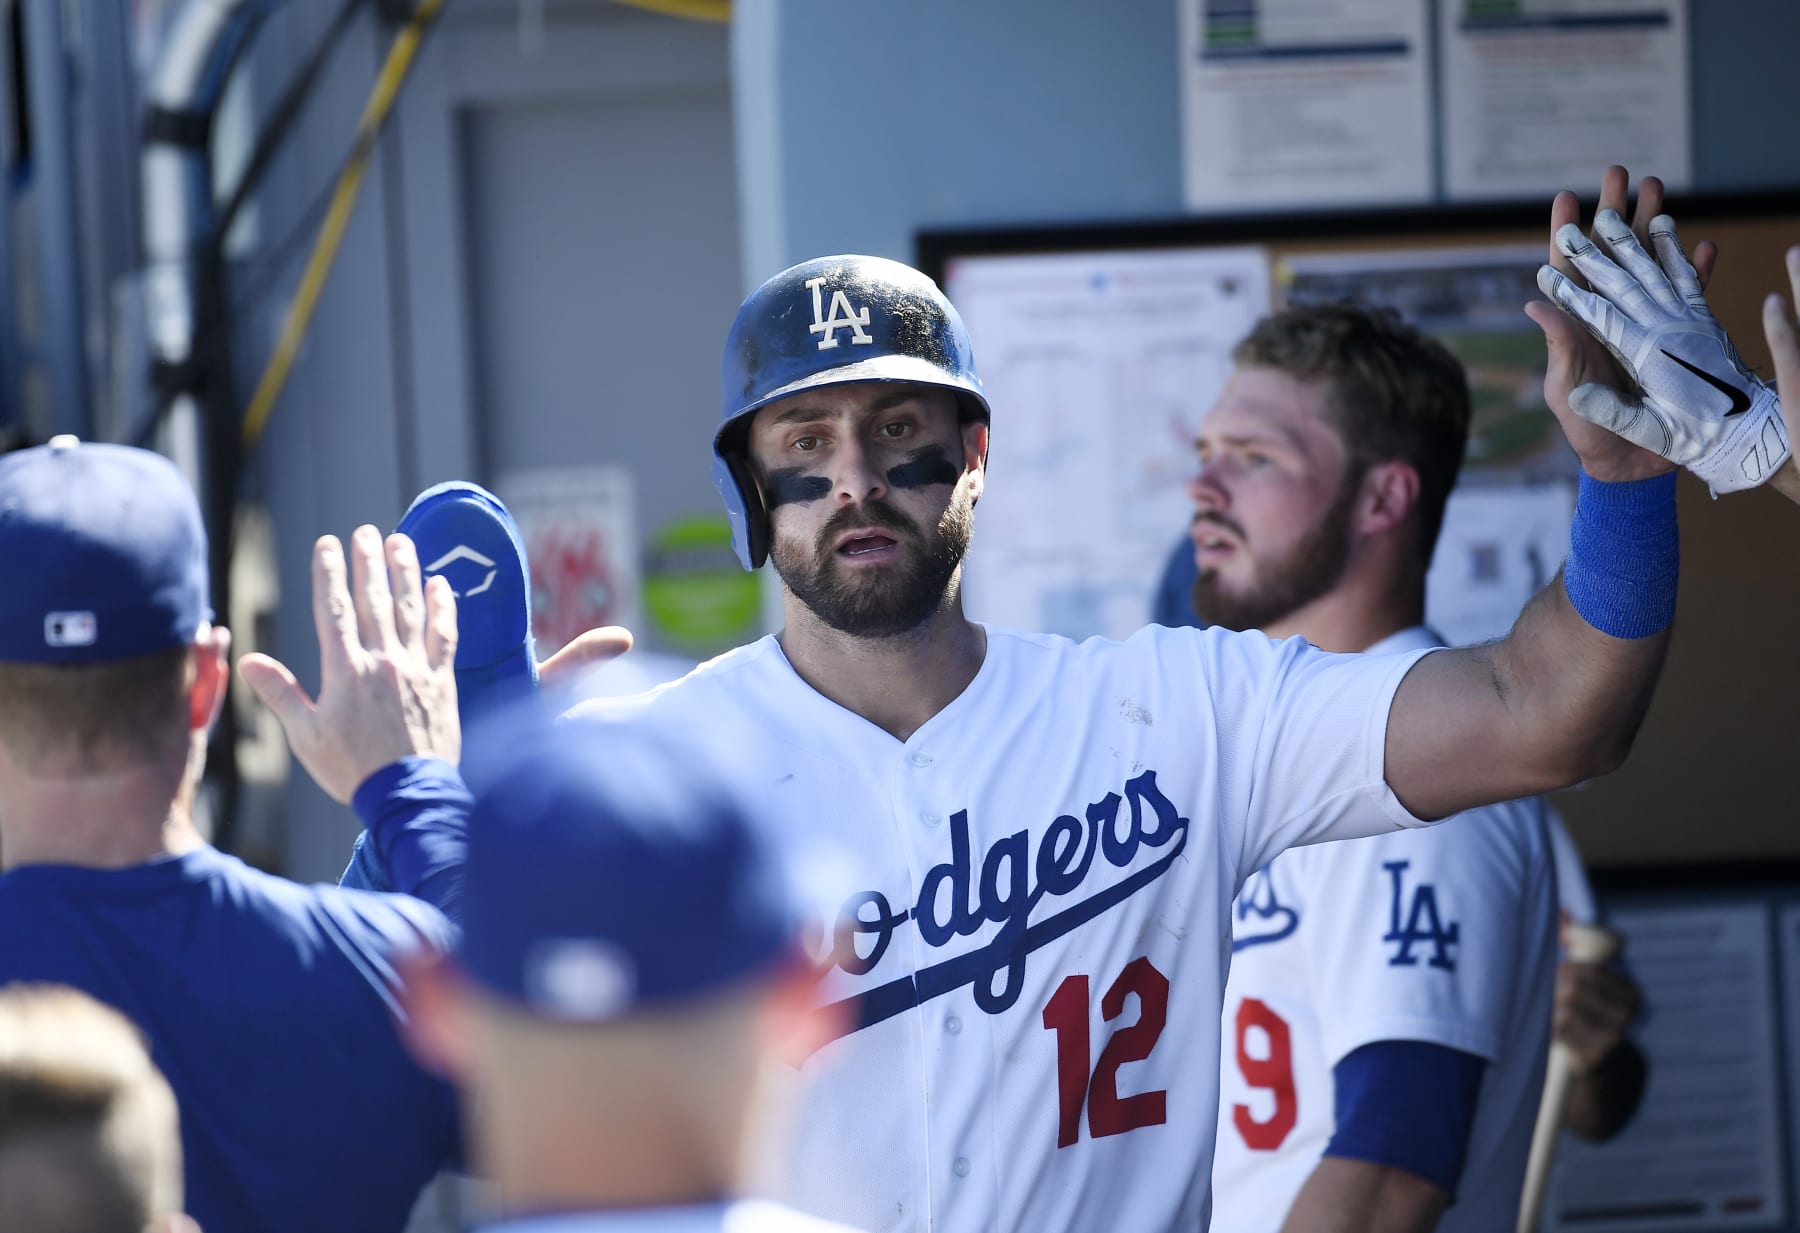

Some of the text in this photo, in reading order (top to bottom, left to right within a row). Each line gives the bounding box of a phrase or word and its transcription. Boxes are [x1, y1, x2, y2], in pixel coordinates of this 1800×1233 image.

[805, 277, 873, 350] LA
[806, 770, 1190, 1015] odgers
[1383, 861, 1459, 971] LA
[1043, 956, 1169, 1149] 12
[1232, 997, 1297, 1152] 9
